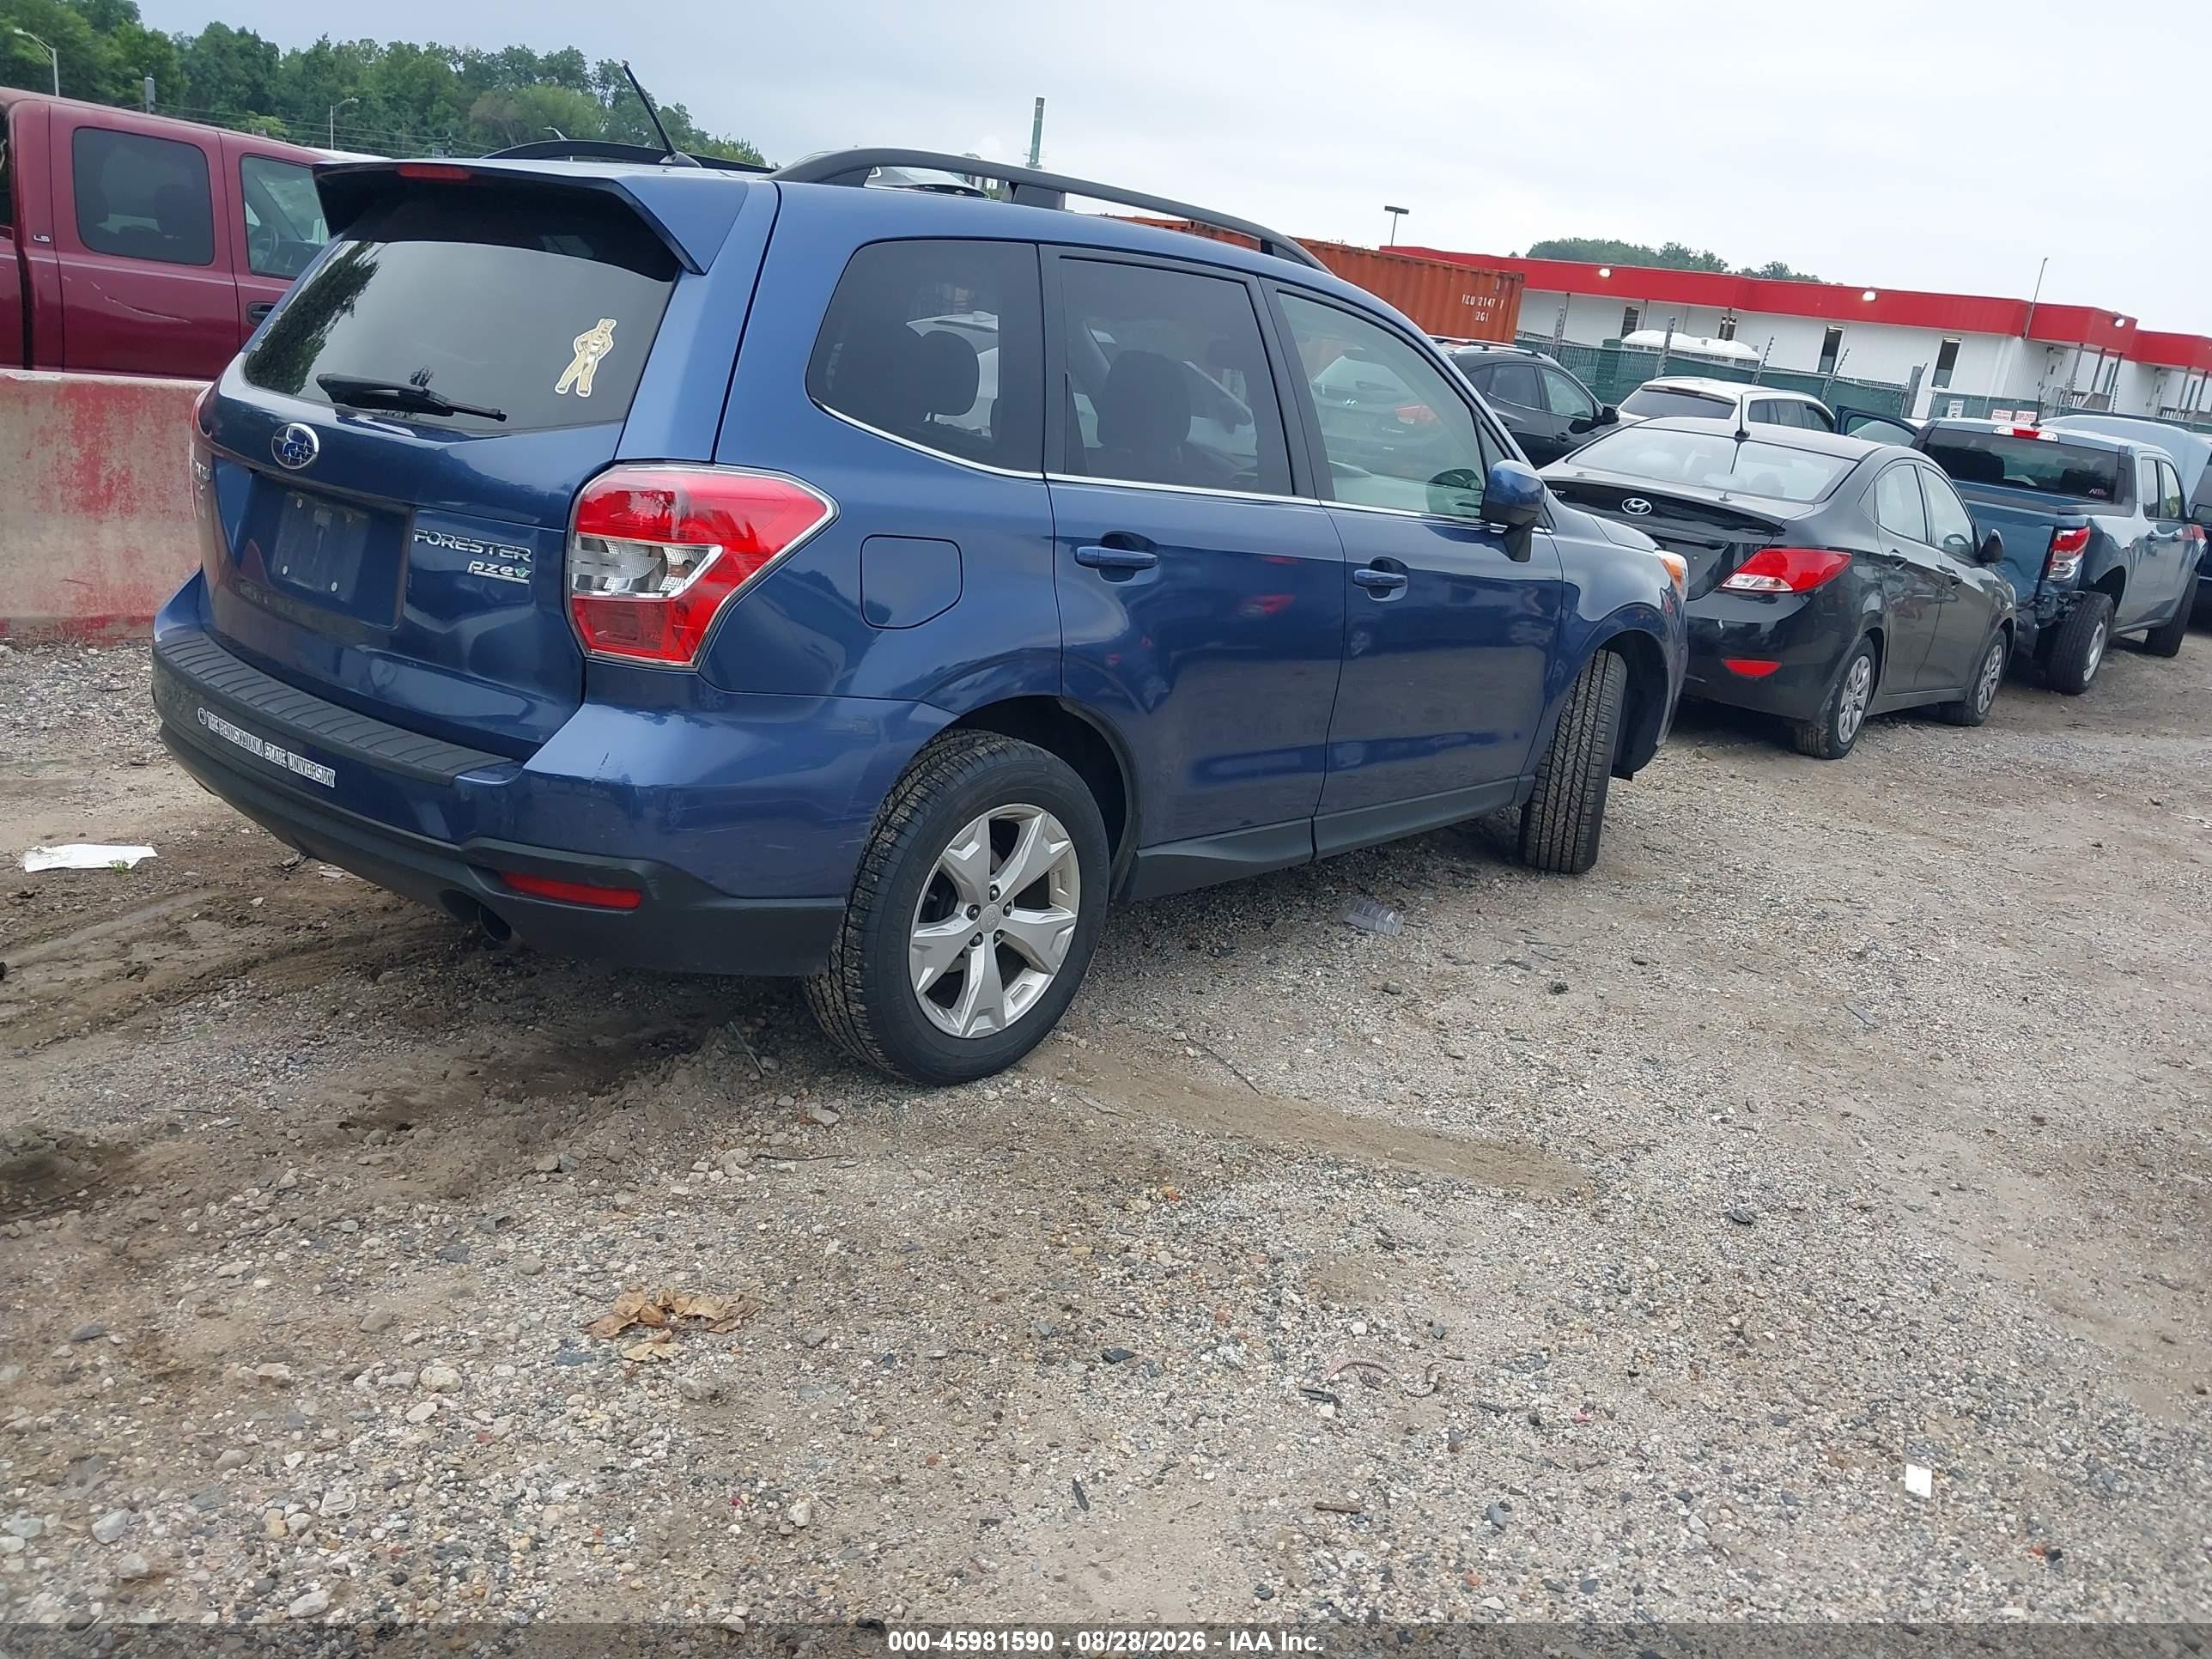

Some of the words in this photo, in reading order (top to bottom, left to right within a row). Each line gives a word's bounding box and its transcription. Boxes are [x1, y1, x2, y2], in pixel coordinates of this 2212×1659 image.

[33, 234, 50, 243] LS
[414, 528, 532, 563] FORESTER
[207, 710, 220, 732] THE
[219, 719, 264, 757] PENNSYLVANIA
[264, 742, 287, 768] STATE
[287, 751, 336, 788] UNIVERSITY
